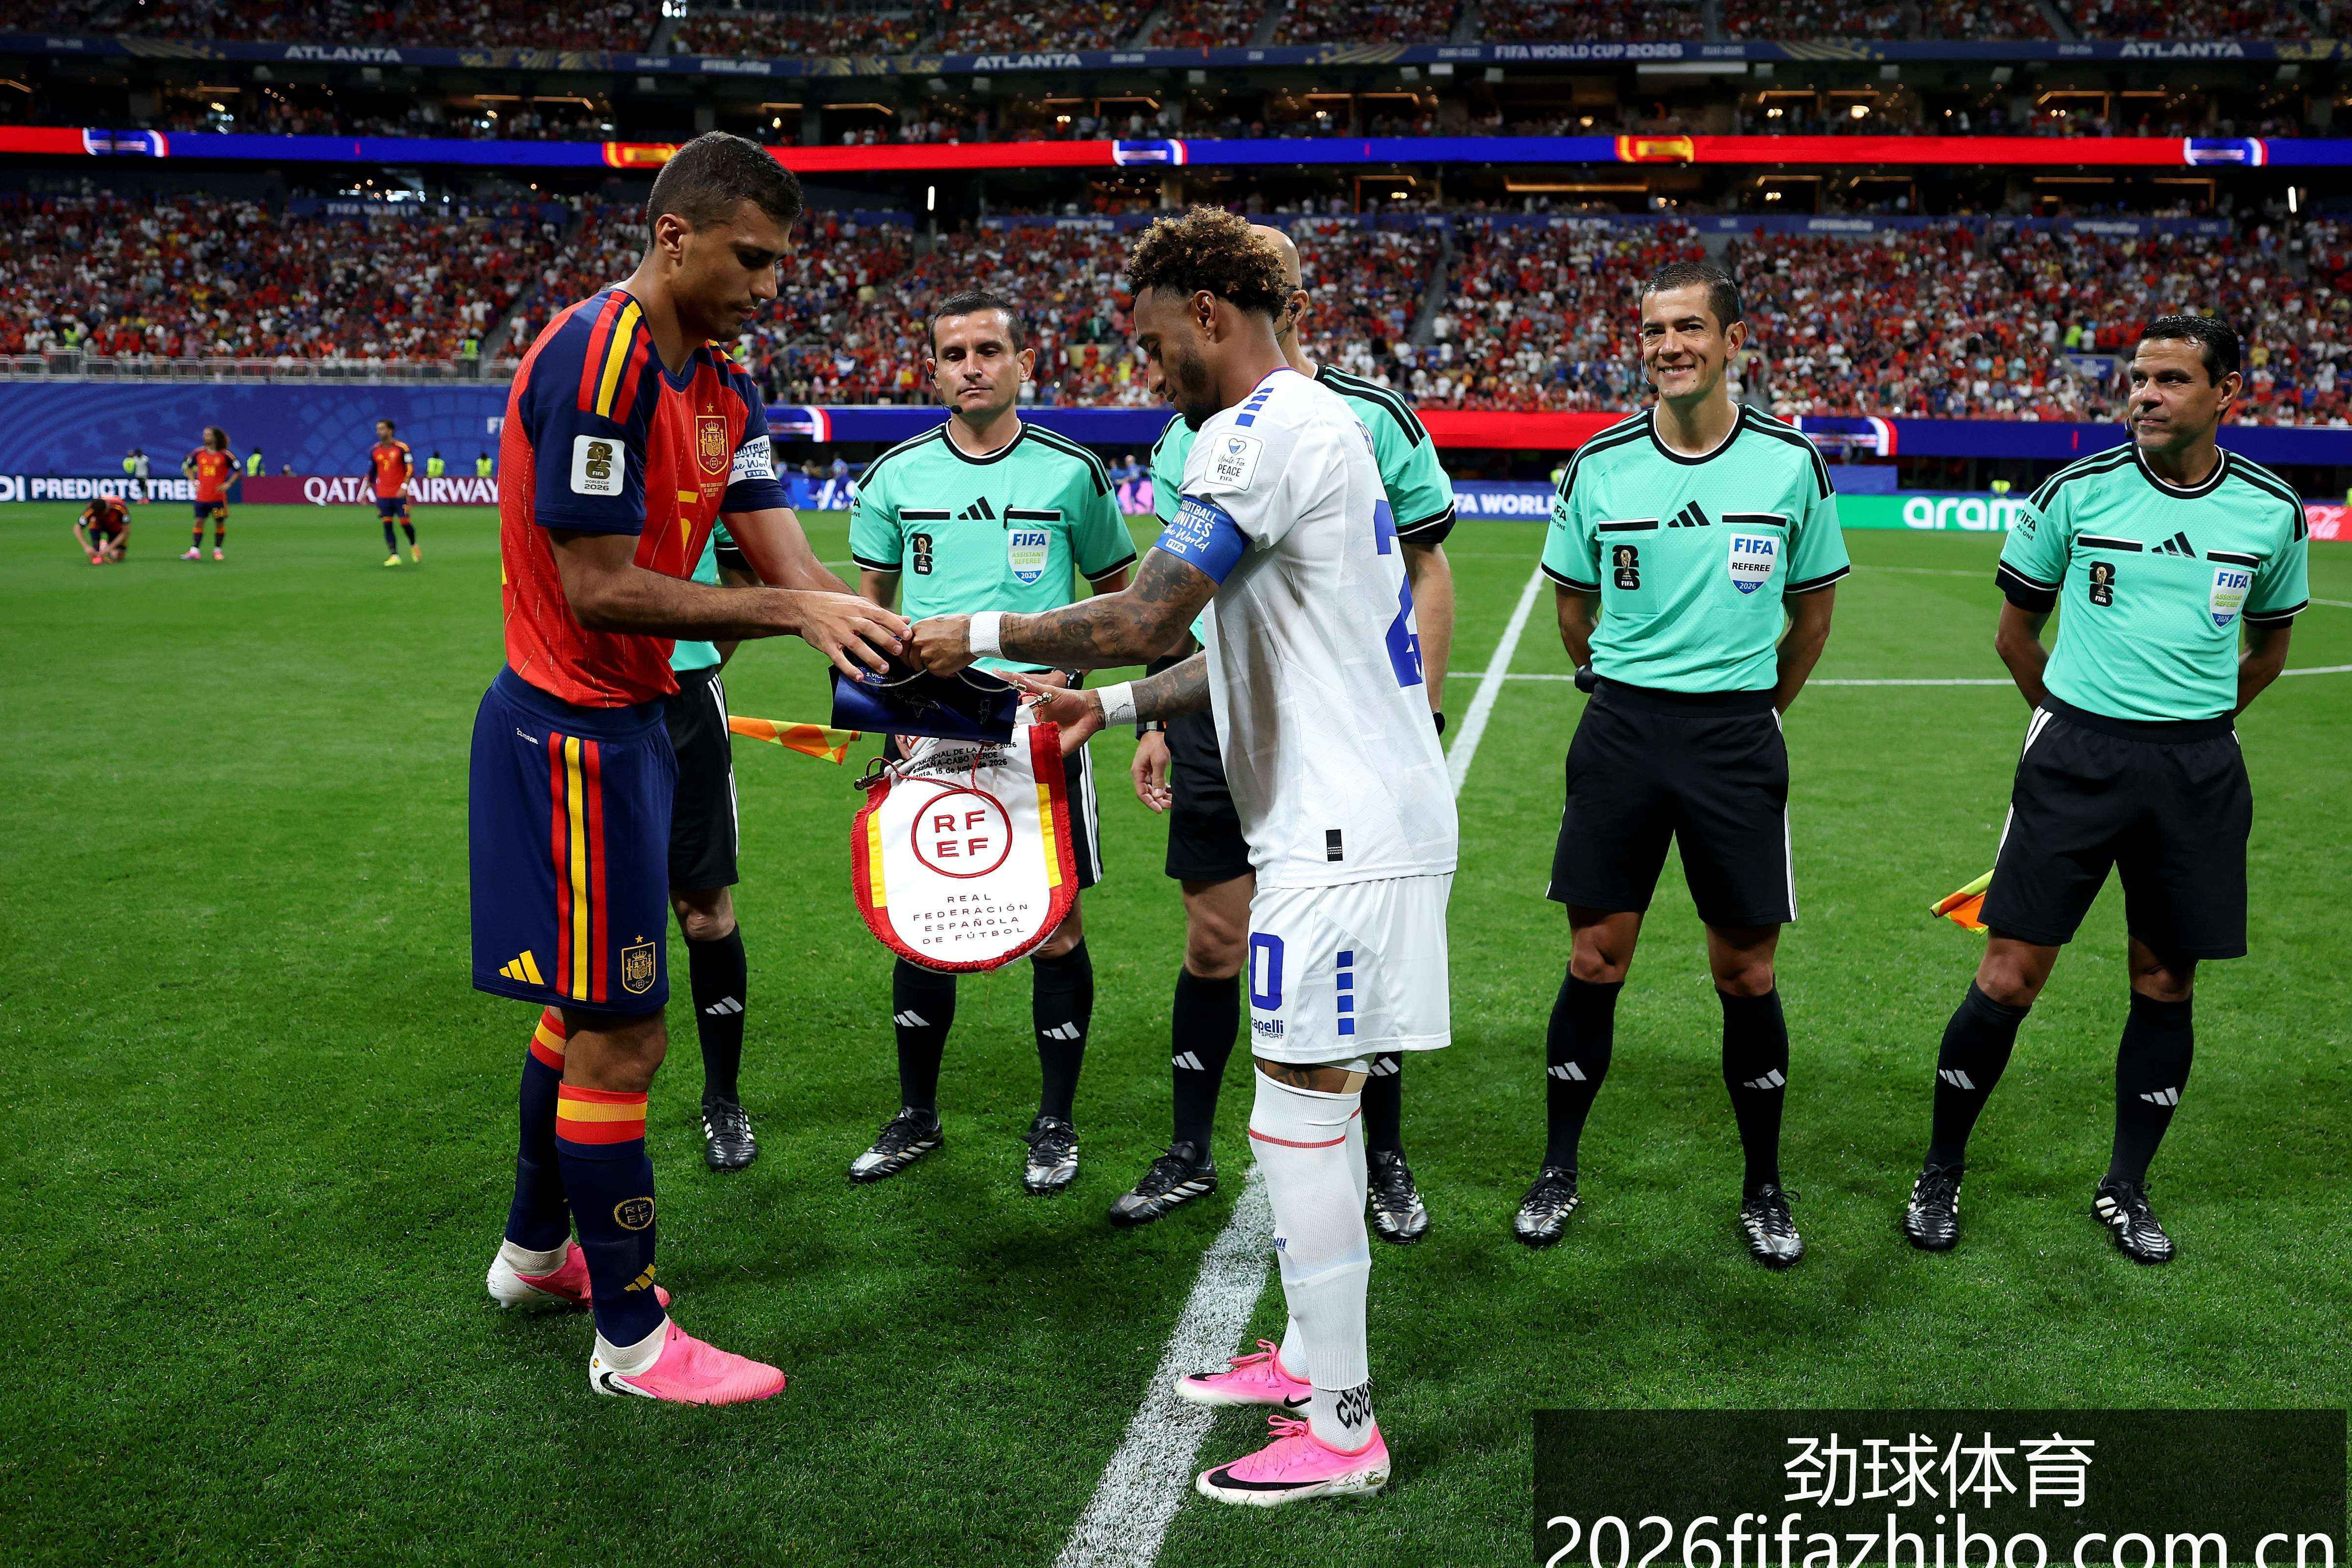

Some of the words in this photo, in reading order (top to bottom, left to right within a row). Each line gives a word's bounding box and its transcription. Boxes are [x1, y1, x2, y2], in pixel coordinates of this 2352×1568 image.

[284, 45, 403, 63] ATLANTA
[1495, 45, 1529, 59] FIFA
[1531, 45, 1589, 59] WORLD
[1592, 44, 1624, 58] CUP
[1626, 43, 1684, 58] 2026
[2119, 42, 2245, 58] ATLANTA
[973, 53, 1082, 70] ATLANTA
[1217, 464, 1242, 478] PEACE
[303, 477, 377, 506] QATA
[408, 477, 499, 504] AIRWAY
[1453, 493, 1479, 514] FA
[1180, 500, 1217, 525] FOOTBALL
[1173, 510, 1213, 538] UNITES
[1012, 534, 1046, 546] FIFA
[1175, 527, 1211, 553] World
[2022, 531, 2034, 541] ONE
[1168, 540, 1183, 551] FIFA
[1734, 538, 1773, 555] FIFA
[1732, 562, 1771, 572] REFEREE
[2217, 572, 2249, 588] FIFA
[919, 750, 951, 766] MUNDIAL
[953, 748, 964, 756] DE
[999, 742, 1017, 750] 2026
[989, 758, 1008, 767] 2026
[947, 893, 992, 903] REAL
[913, 903, 1029, 922] FEDERACIÓN
[924, 916, 1019, 933] ESPAÑOLA
[922, 936, 943, 945] DE
[955, 927, 1025, 941] FÚTBOL
[1261, 1031, 1284, 1039] SPORT
